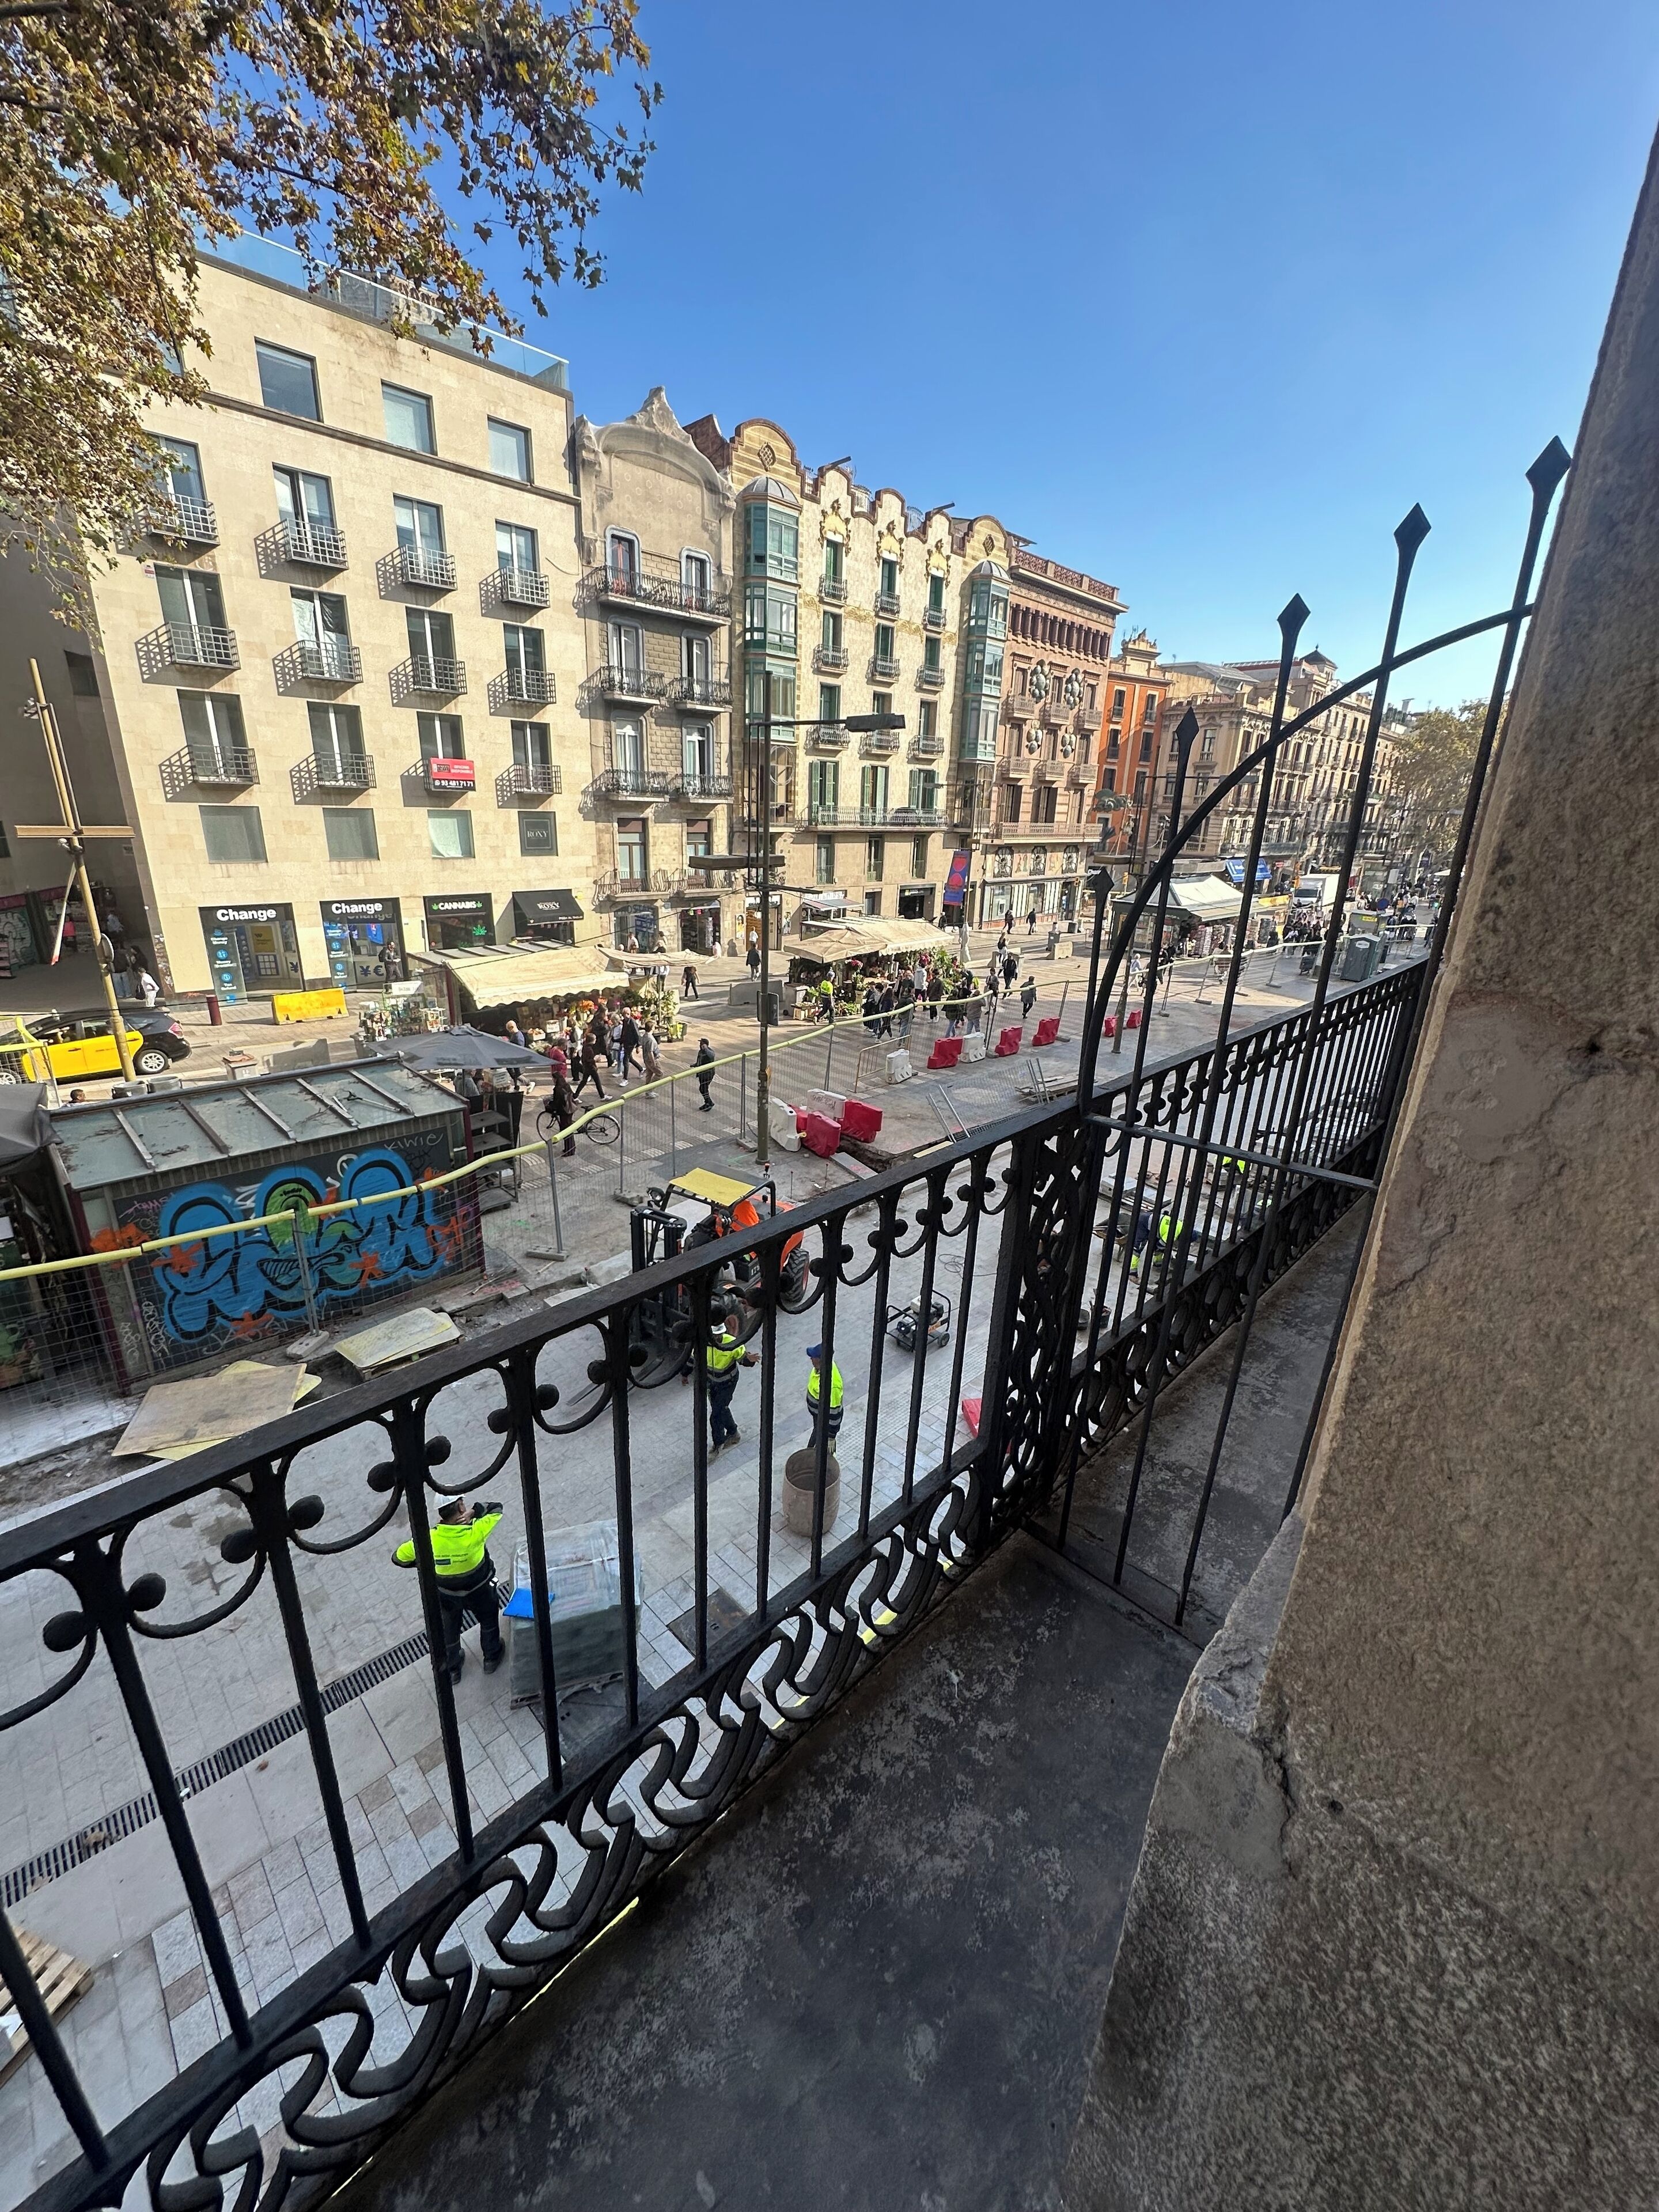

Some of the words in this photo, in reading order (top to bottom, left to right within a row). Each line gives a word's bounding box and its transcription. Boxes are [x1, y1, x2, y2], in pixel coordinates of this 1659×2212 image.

[331, 903, 383, 914] Change
[438, 901, 478, 910] CANNABIS
[216, 908, 276, 922] Change
[384, 1133, 444, 1150] KIWIE
